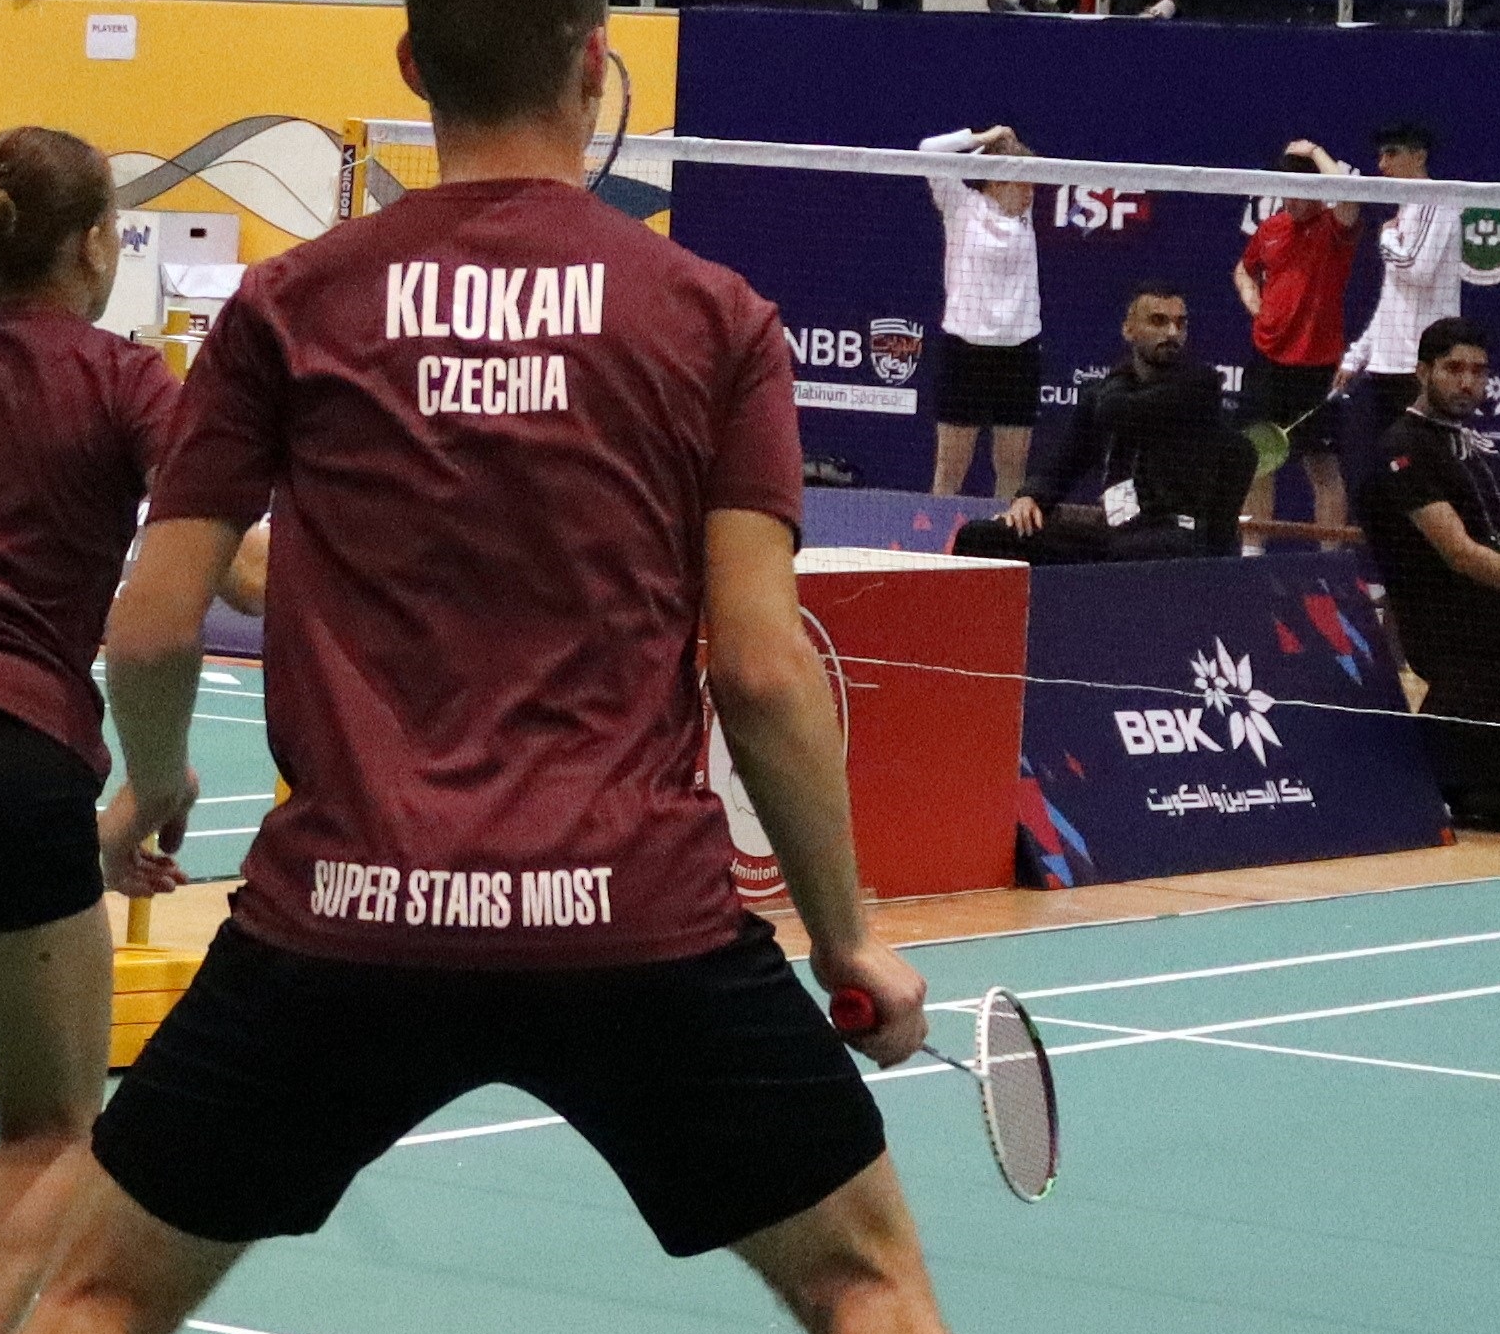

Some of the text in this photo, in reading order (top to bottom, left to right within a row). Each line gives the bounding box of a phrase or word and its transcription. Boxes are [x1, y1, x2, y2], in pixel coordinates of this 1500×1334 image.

[91, 23, 128, 34] PLAYERS
[385, 261, 606, 341] KLOKAN
[415, 354, 569, 416] CZECHIA
[1114, 706, 1226, 756] BBK
[310, 858, 614, 930] SUPER STARS MOST
